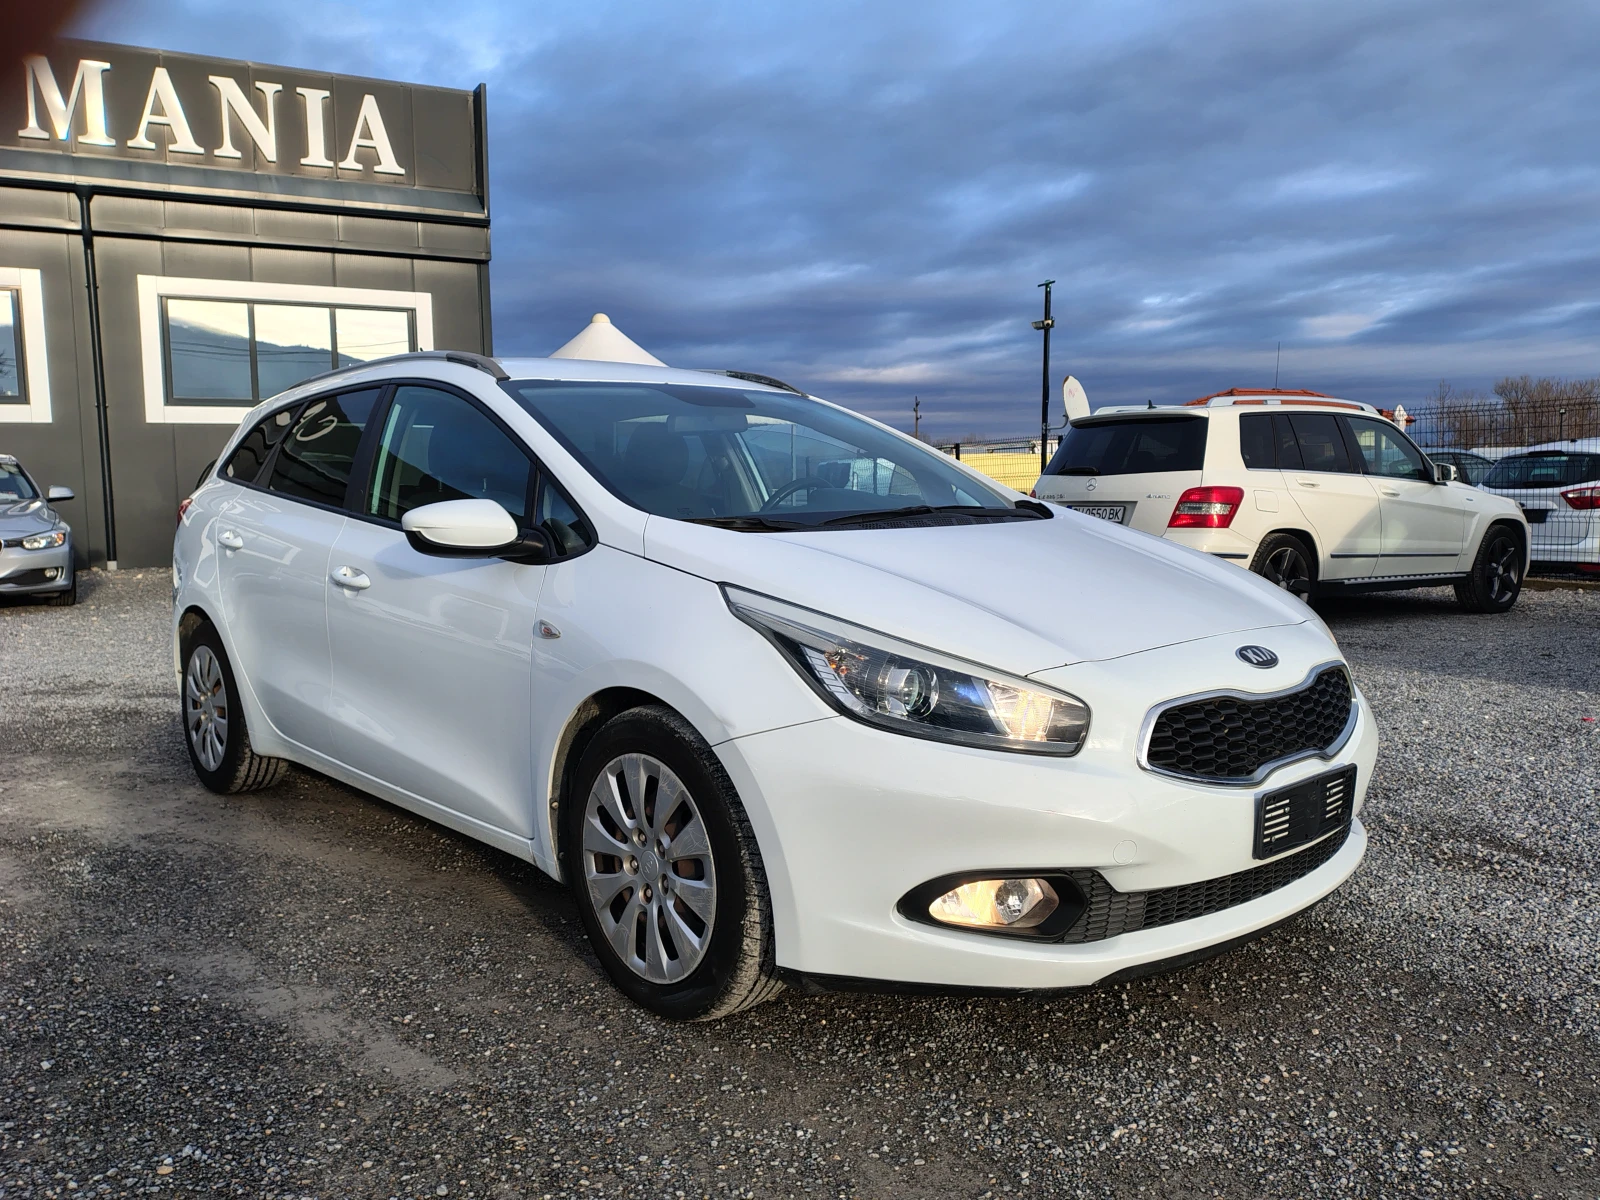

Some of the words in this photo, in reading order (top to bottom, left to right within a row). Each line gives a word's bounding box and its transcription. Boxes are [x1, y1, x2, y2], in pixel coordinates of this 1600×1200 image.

[18, 54, 406, 175] MANIA
[1108, 508, 1122, 521] BK
[1240, 647, 1276, 664] KIA
